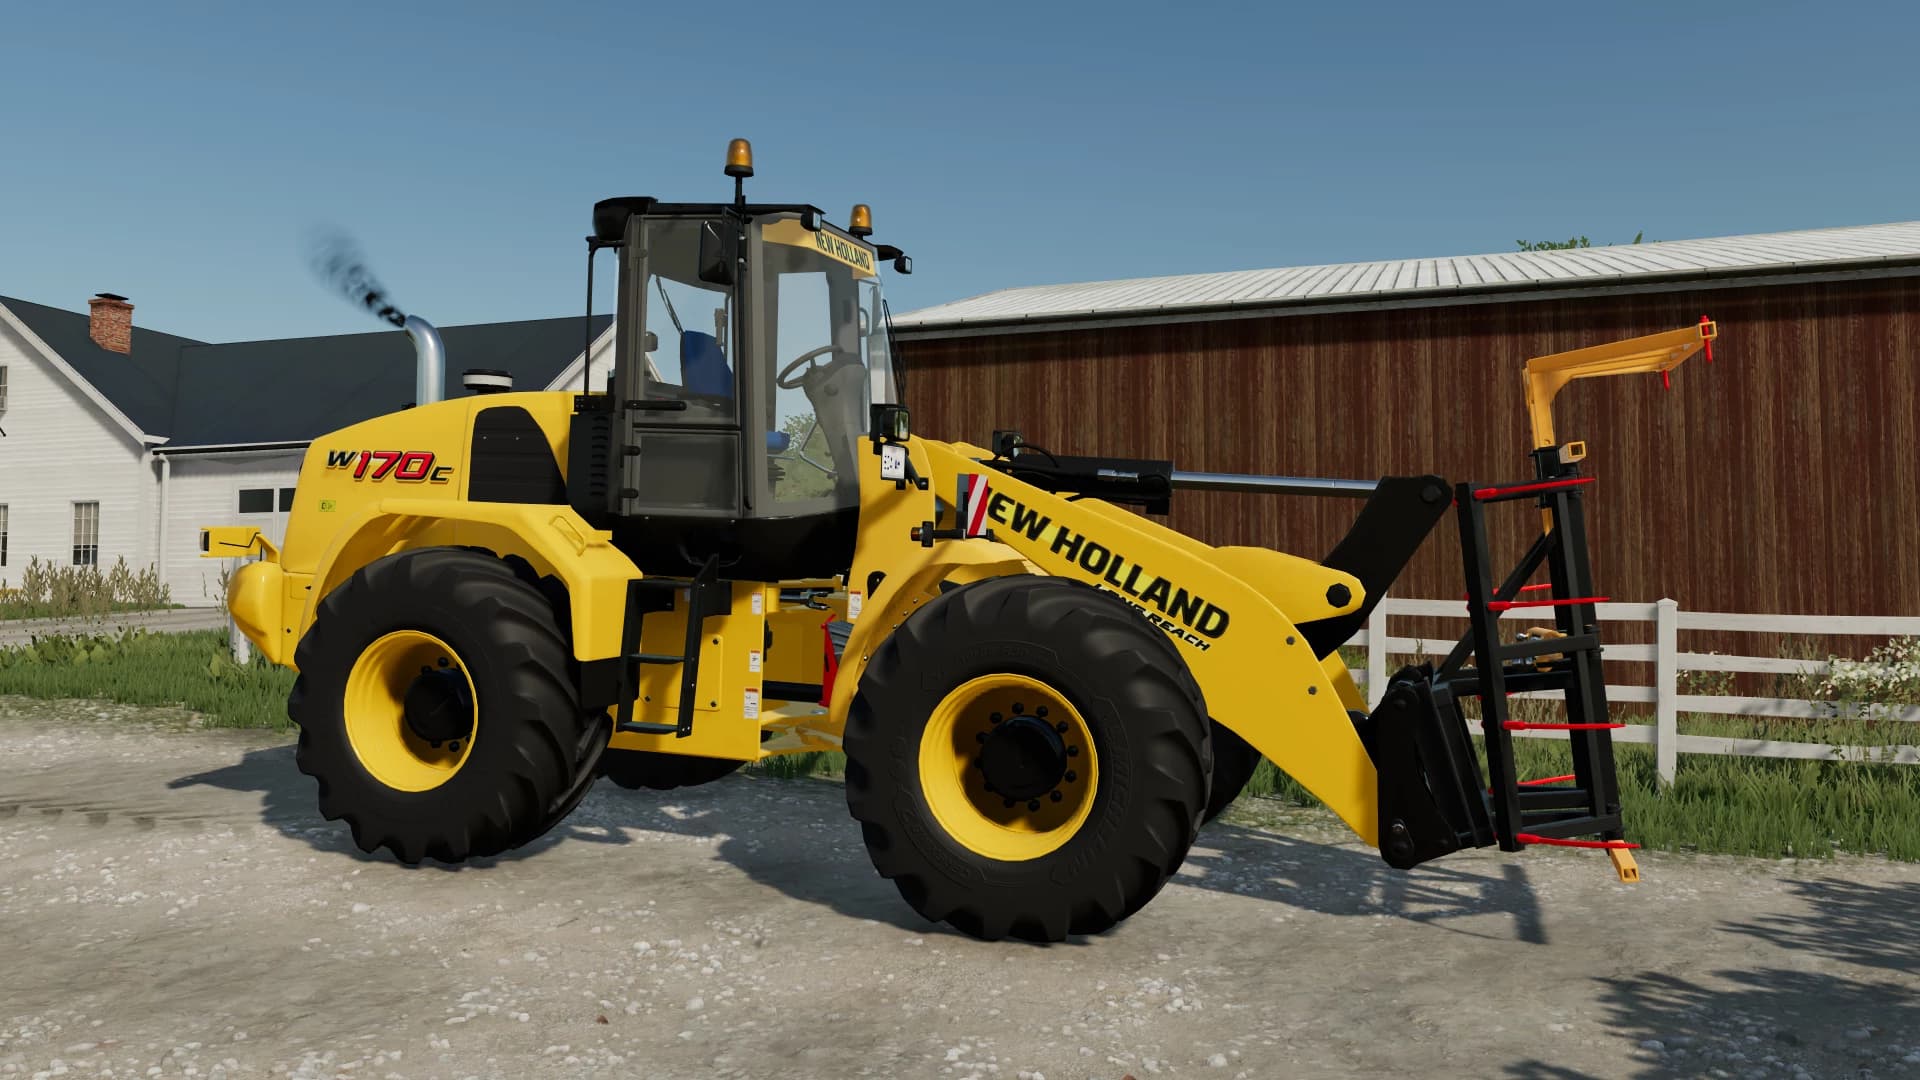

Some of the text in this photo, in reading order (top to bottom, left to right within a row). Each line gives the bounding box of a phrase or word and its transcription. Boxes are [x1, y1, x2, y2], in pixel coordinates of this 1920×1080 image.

[815, 231, 870, 270] NEW HOLLAND
[987, 487, 1230, 639] EW HOLLAND
[1146, 613, 1210, 651] REACH
